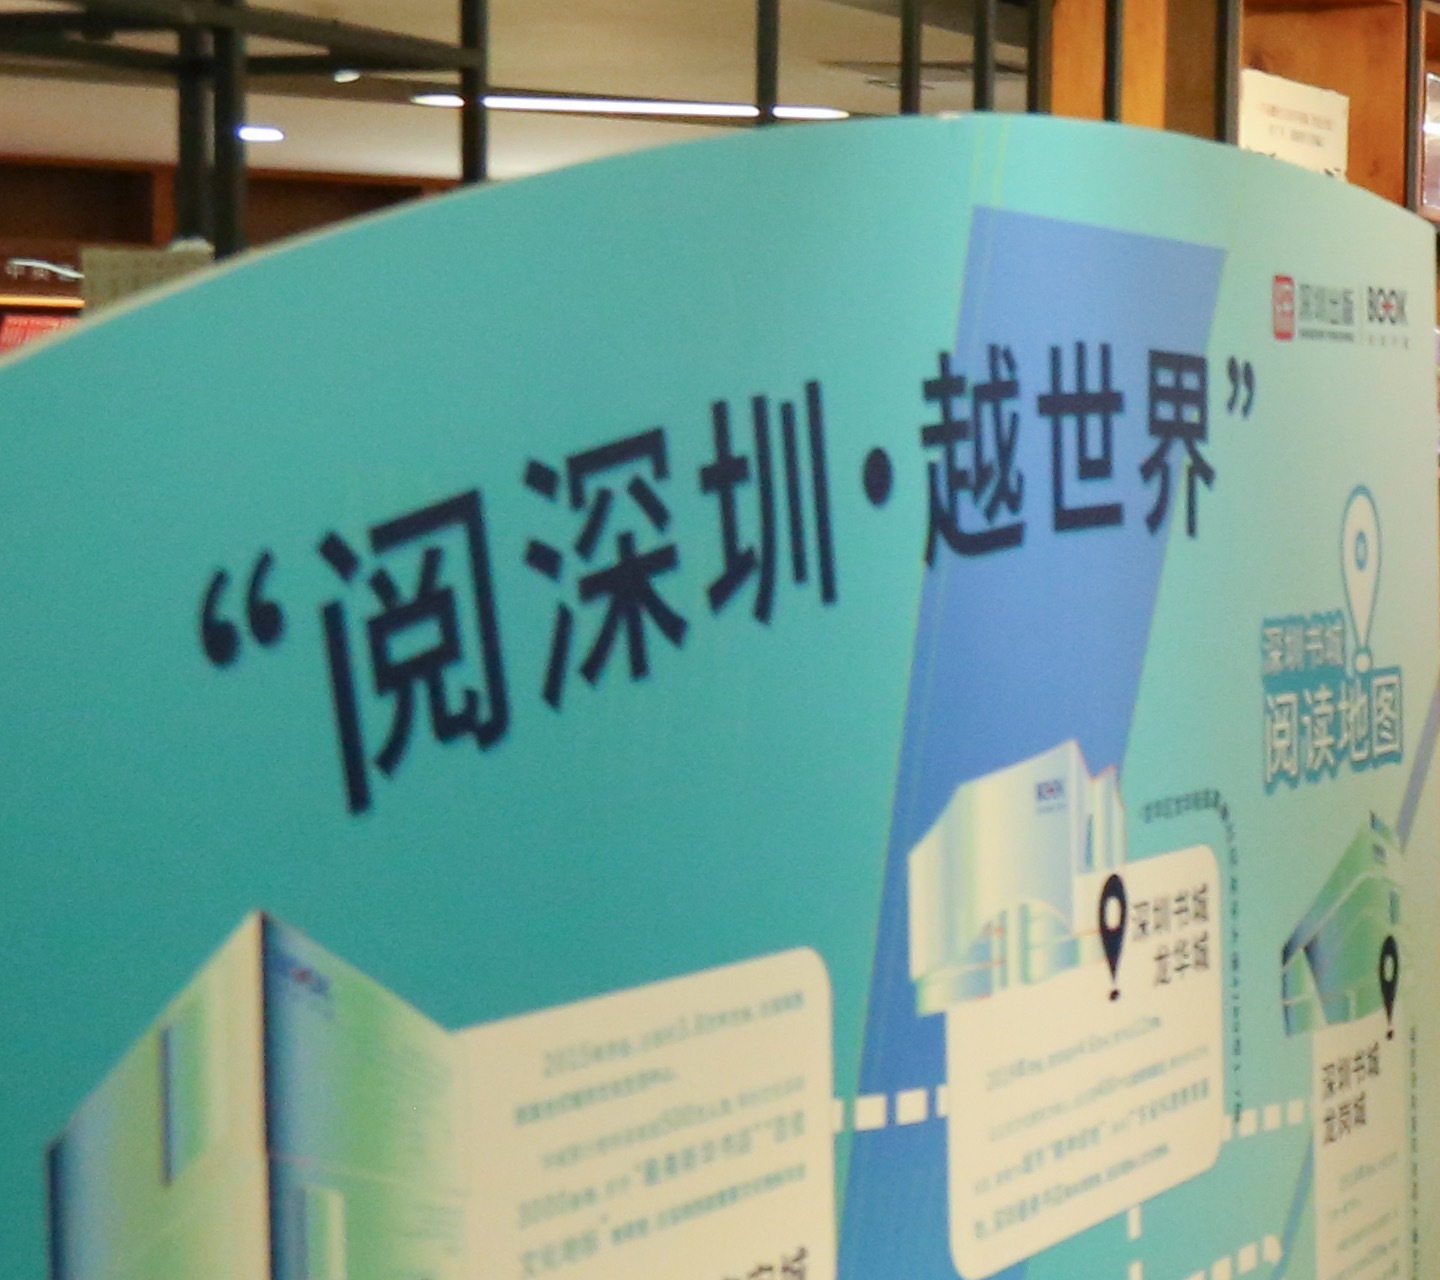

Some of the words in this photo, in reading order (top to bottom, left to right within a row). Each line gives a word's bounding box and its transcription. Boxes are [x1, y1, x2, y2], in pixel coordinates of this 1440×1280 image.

[199, 341, 1256, 815] “阅深圳·越世界”
[1265, 675, 1401, 784] 阅读地图
